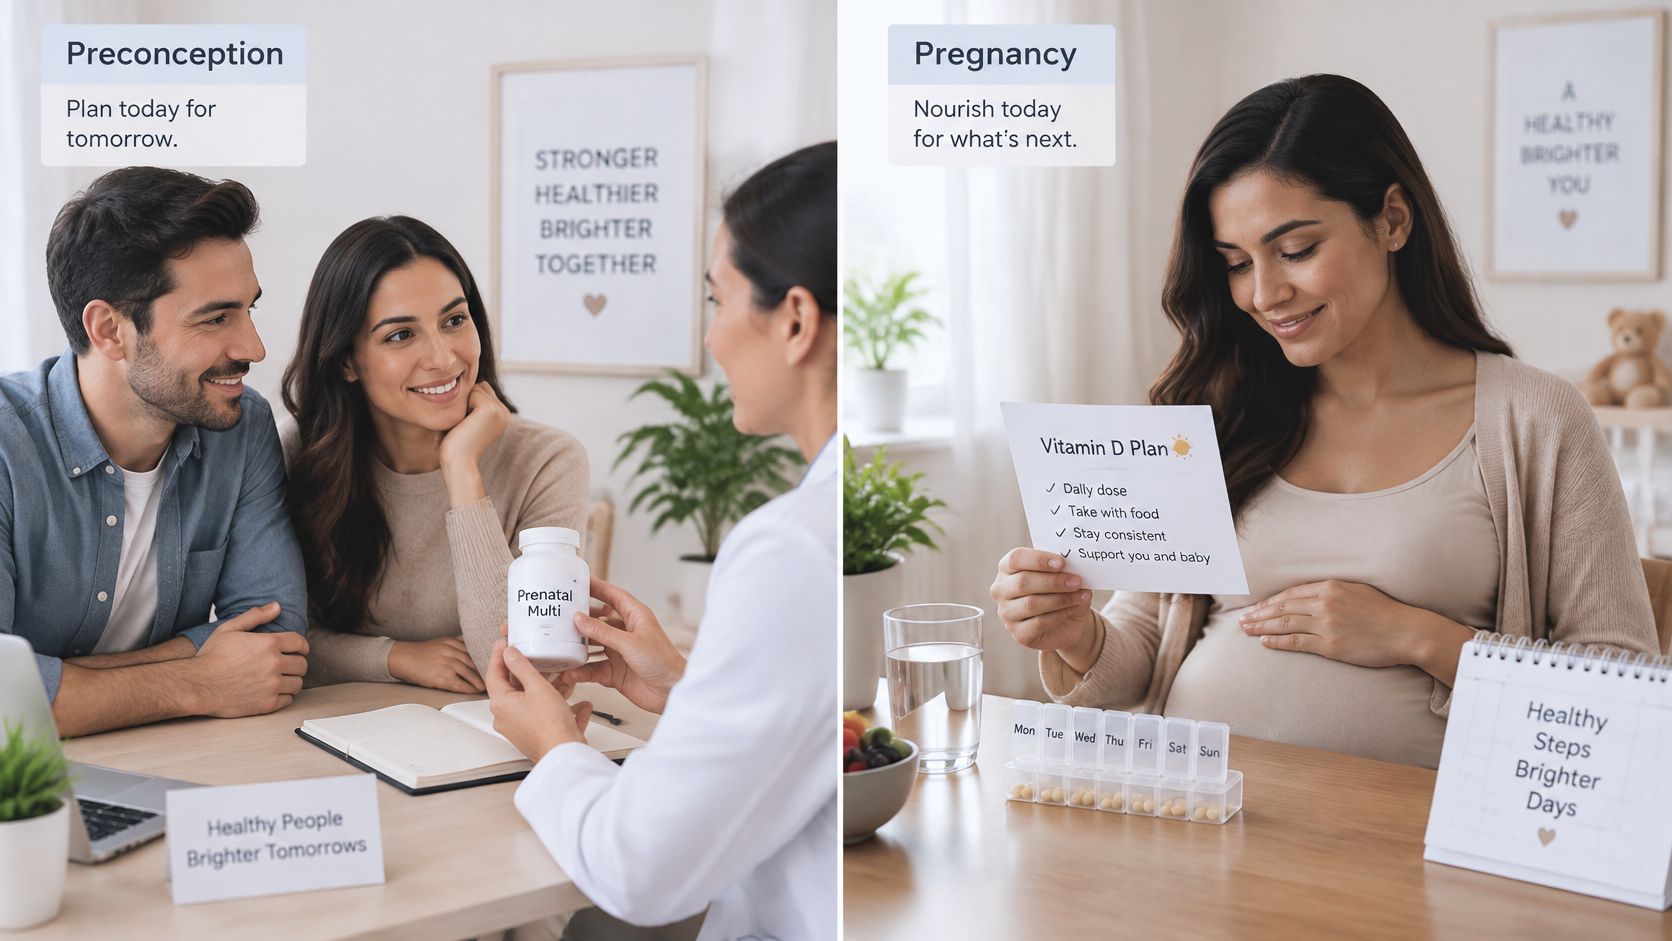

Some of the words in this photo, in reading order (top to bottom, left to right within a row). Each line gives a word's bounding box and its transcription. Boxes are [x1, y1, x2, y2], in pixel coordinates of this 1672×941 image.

[1562, 82, 1576, 100] A
[1524, 112, 1615, 134] HEALTHY
[536, 147, 658, 170] STRONGER
[1520, 142, 1619, 165] BRIGHTER
[535, 183, 658, 205] HEALTHIER
[1548, 174, 1590, 195] YOU
[540, 218, 652, 239] BRIGHTER
[536, 254, 656, 274] TOGETHER
[1040, 437, 1105, 455] Vitamin
[1111, 440, 1124, 455] D
[1130, 440, 1168, 456] Plan
[1098, 484, 1127, 496] dose
[1069, 505, 1097, 517] Take
[1101, 507, 1127, 518] with
[1130, 507, 1159, 519] food
[1074, 527, 1100, 542] Stay
[1105, 530, 1167, 541] consistent
[1079, 548, 1125, 561] Support
[1128, 553, 1150, 563] you
[1154, 552, 1176, 561] and
[1180, 552, 1210, 565] baby
[518, 589, 572, 602] Prenatal
[528, 605, 560, 616] Multi
[1527, 701, 1608, 735] Healthy
[1014, 724, 1035, 735] Mon
[1046, 728, 1063, 739] Tue
[1075, 731, 1096, 743] Wed
[1106, 734, 1124, 746] Thu
[1139, 739, 1152, 749] Fri
[1169, 742, 1186, 754] Sat
[1200, 746, 1220, 758] Sun
[1534, 732, 1592, 760] Steps
[1516, 759, 1601, 789] Brighter
[1527, 791, 1577, 819] Days
[208, 816, 276, 836] Healthy
[282, 811, 343, 831] People
[187, 847, 260, 869] Brighter
[266, 838, 367, 860] Tomorrows
